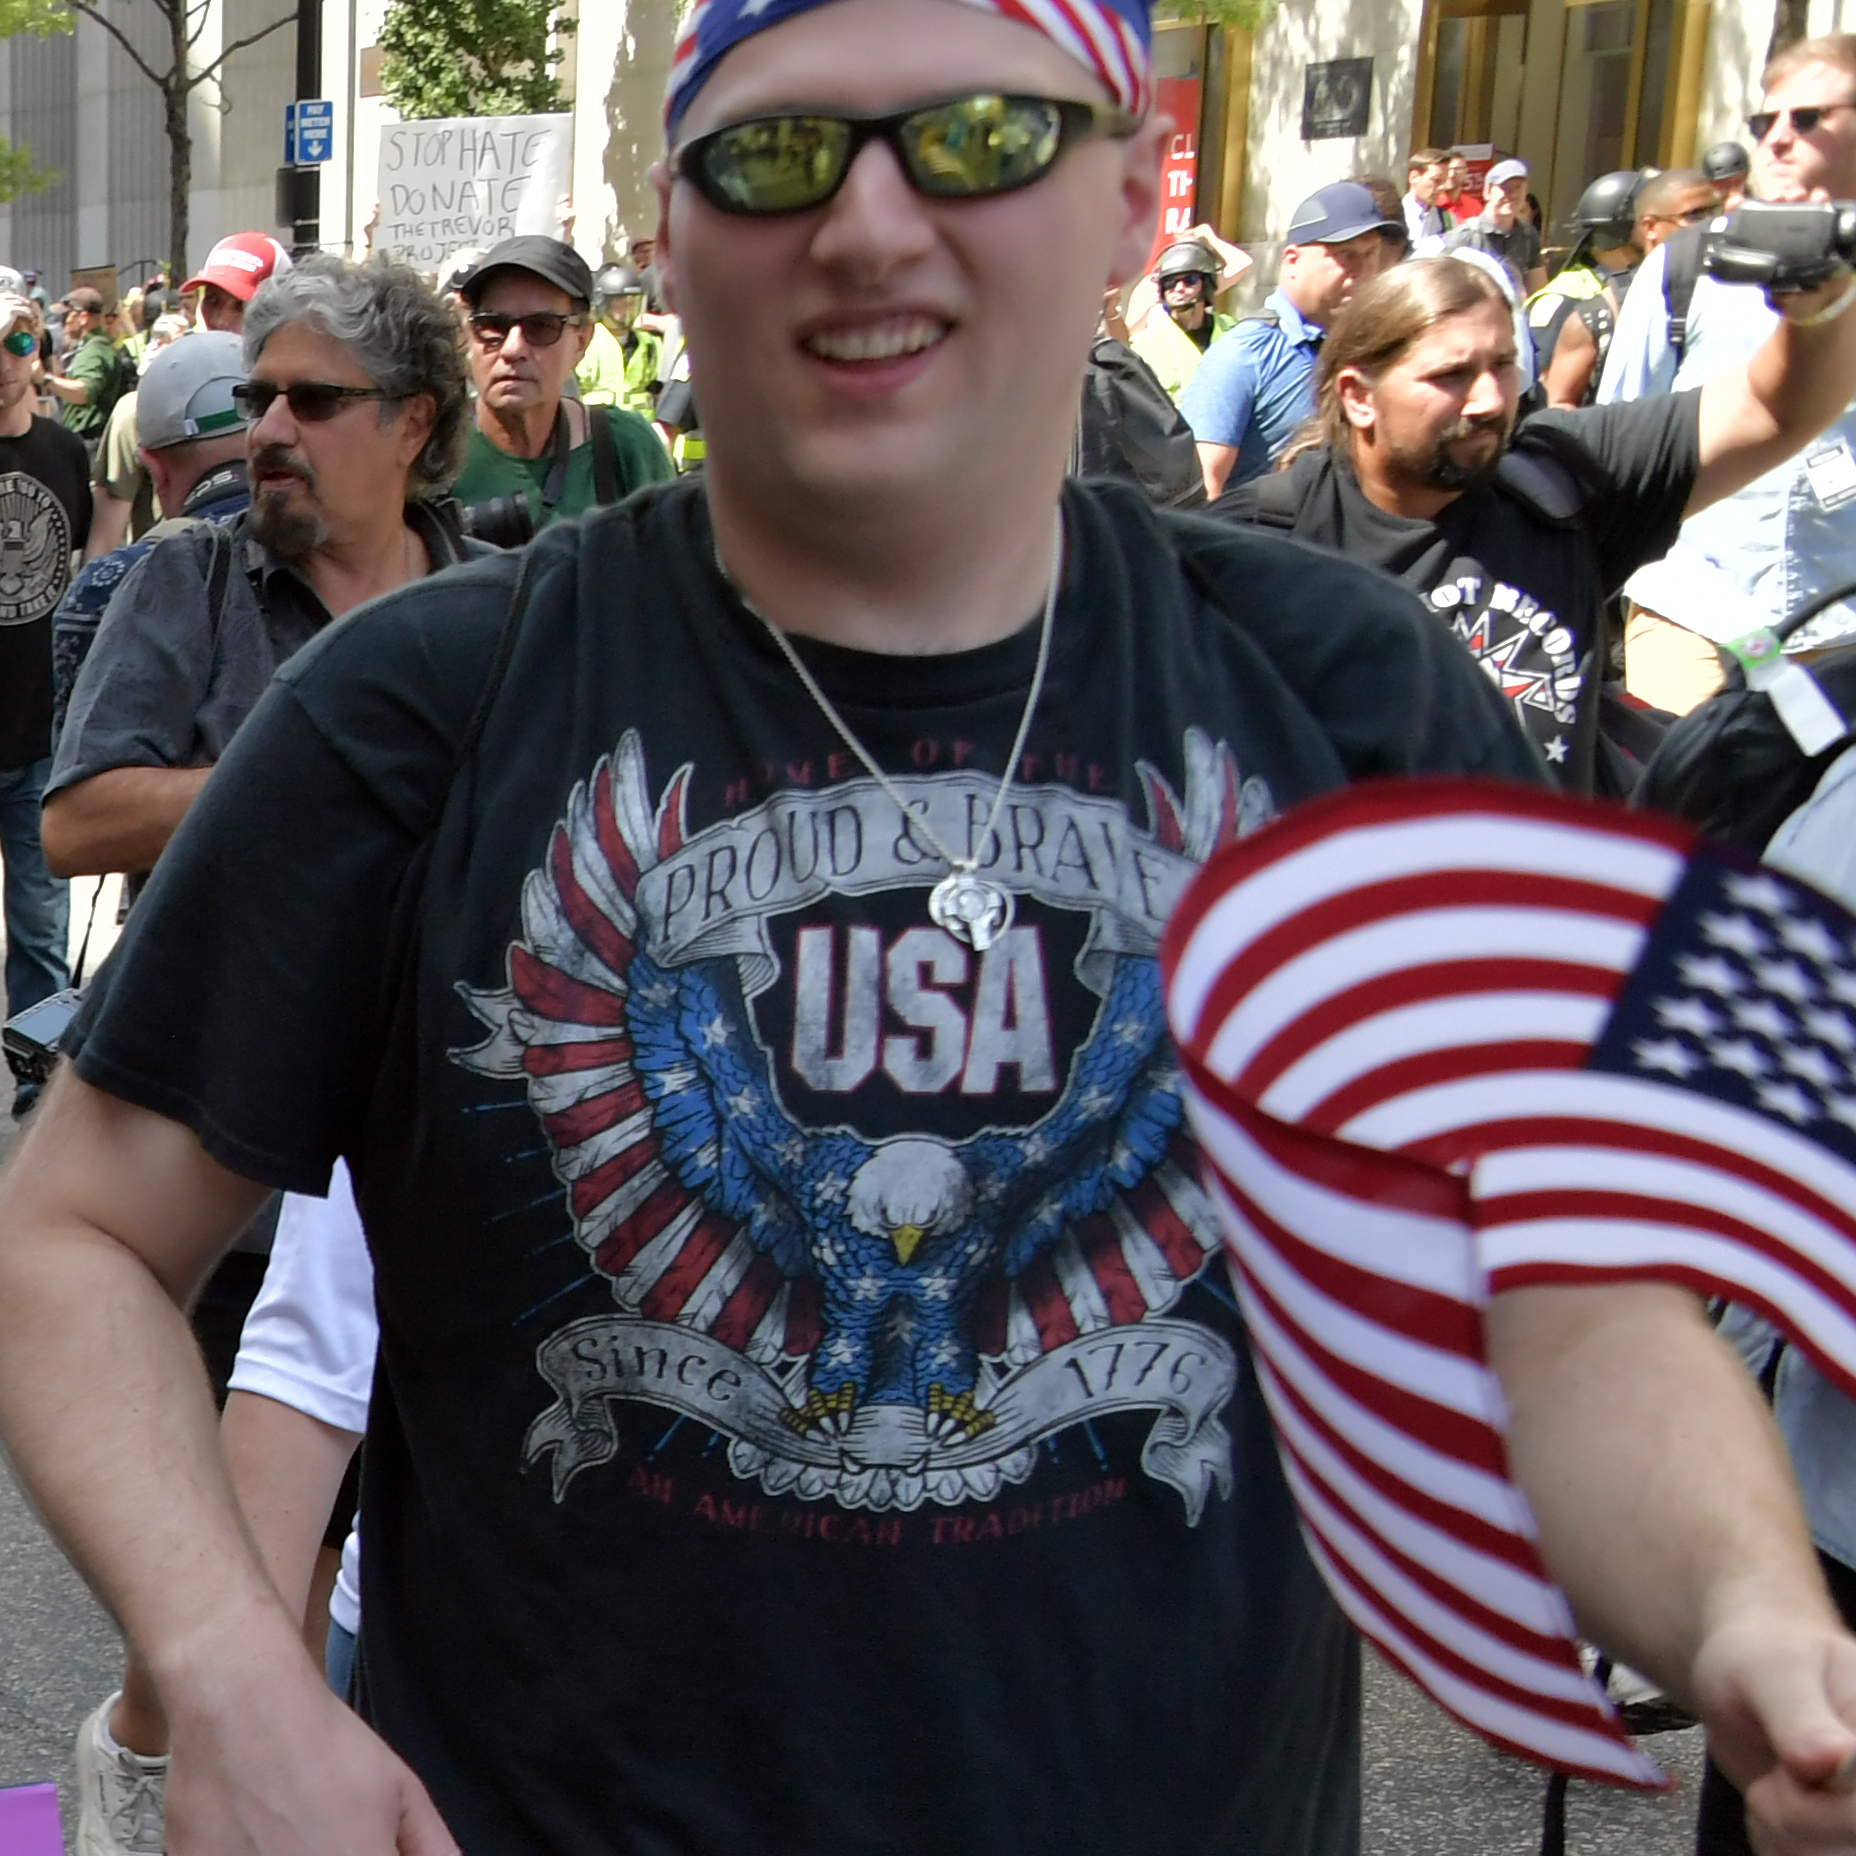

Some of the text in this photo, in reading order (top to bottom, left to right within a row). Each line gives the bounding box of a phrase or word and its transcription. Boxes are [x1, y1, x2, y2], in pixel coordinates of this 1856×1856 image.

[386, 128, 553, 177] STOP HATE
[390, 175, 532, 217] DONATE
[387, 215, 516, 241] THE TREVOR
[910, 738, 974, 767] OF
[664, 792, 1167, 941] PROUD & BRAVE
[790, 924, 1058, 1094] USA
[571, 1337, 1208, 1403] Since 1776
